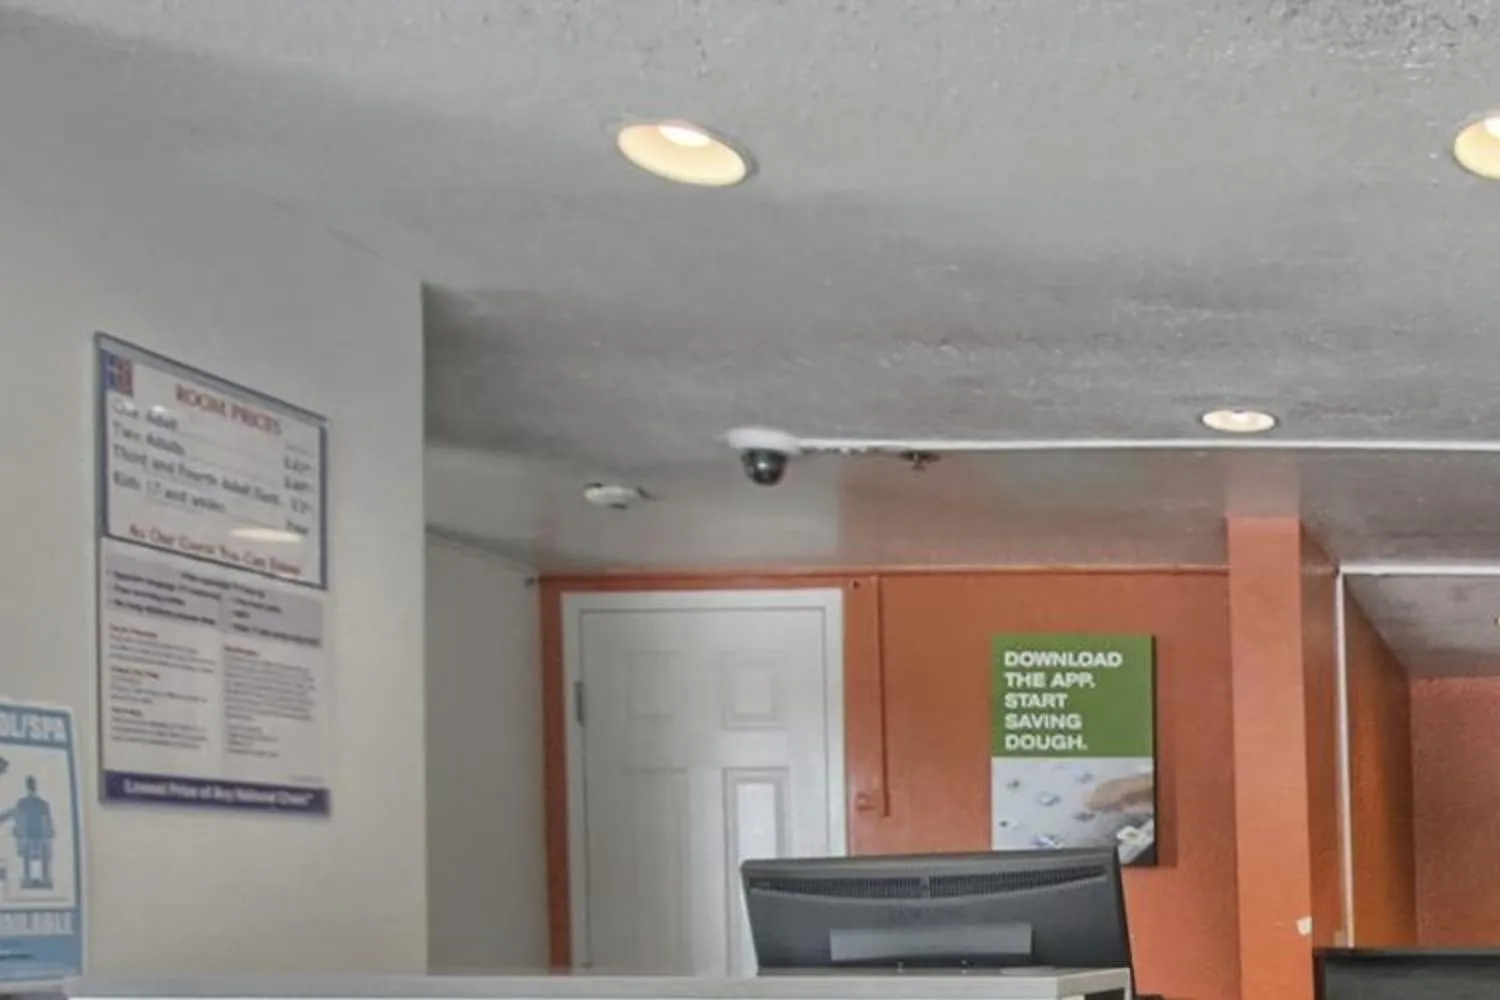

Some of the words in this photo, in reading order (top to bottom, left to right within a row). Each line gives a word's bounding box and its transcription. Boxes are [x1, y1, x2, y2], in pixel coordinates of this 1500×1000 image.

[174, 383, 227, 416] ROOM
[1003, 651, 1123, 668] DOWNLOAD
[1003, 672, 1046, 688] THE
[1050, 672, 1097, 688] APP.
[1003, 692, 1069, 709] START
[1003, 713, 1083, 730] SAVING
[1003, 734, 1089, 751] DOUGH.
